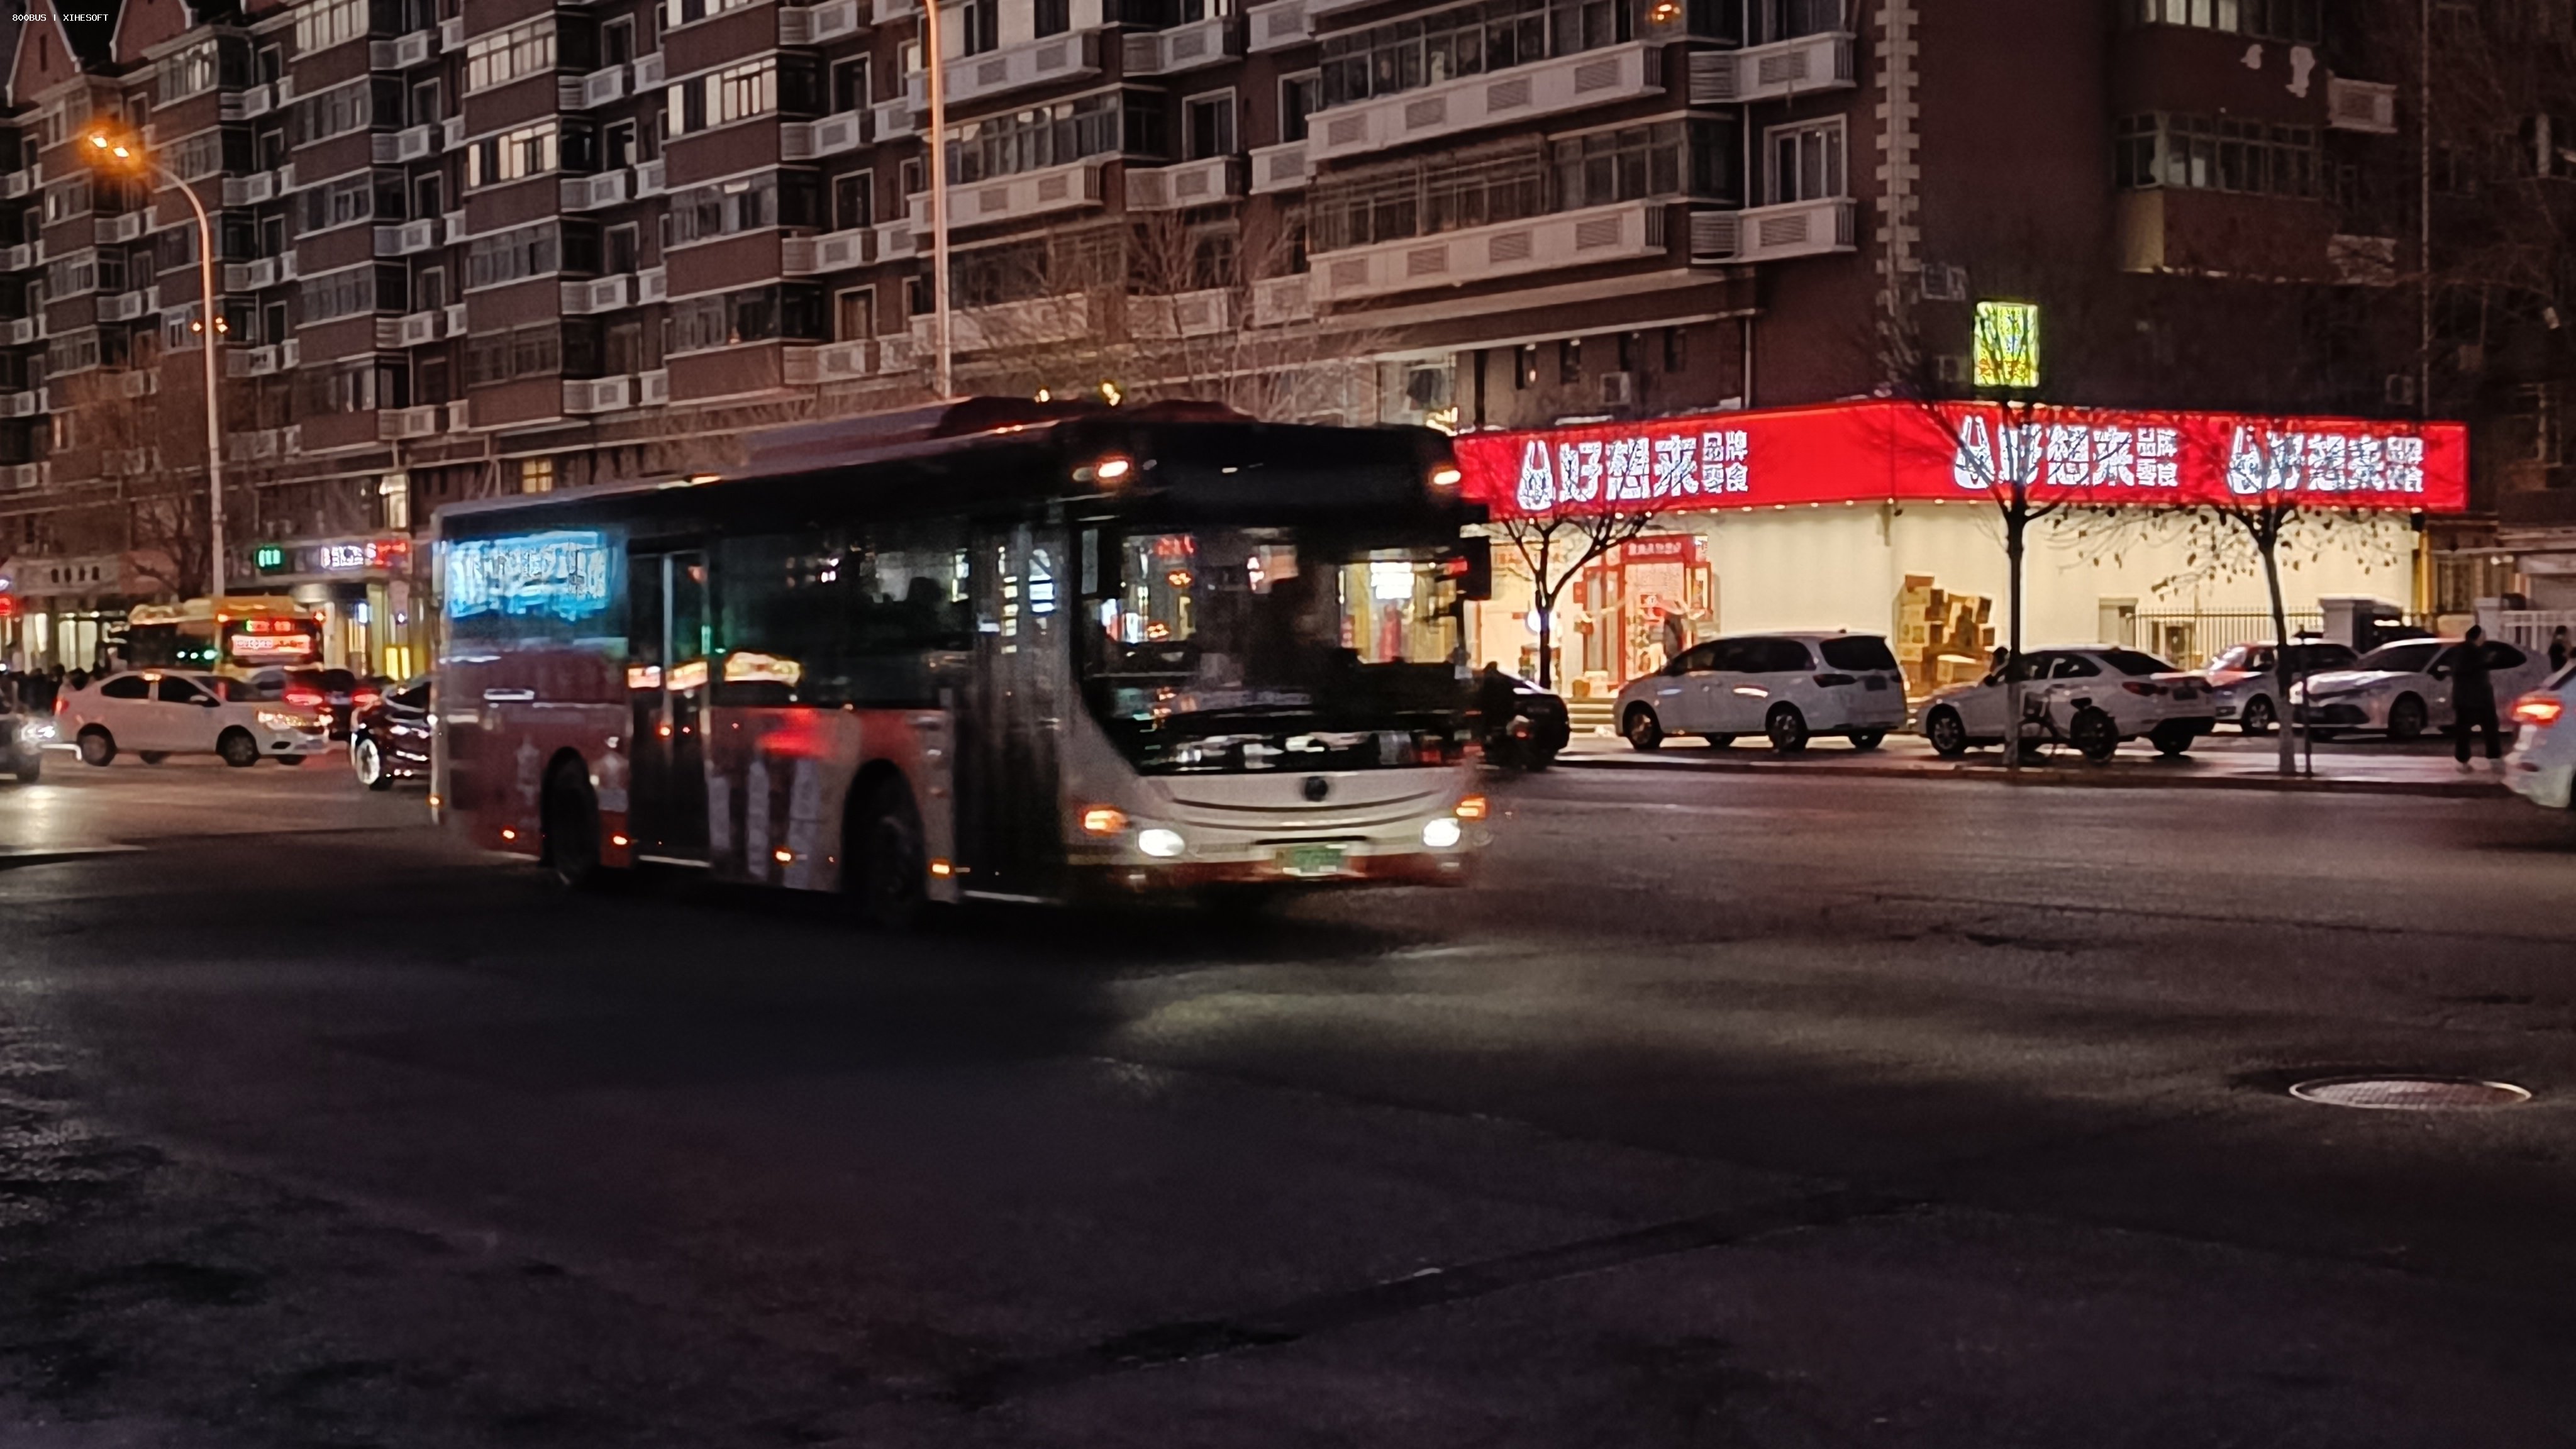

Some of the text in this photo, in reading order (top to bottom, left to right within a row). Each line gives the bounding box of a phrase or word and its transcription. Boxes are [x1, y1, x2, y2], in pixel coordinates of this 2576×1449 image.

[1559, 435, 1699, 502] 好想来
[1702, 430, 1748, 462] 品牌
